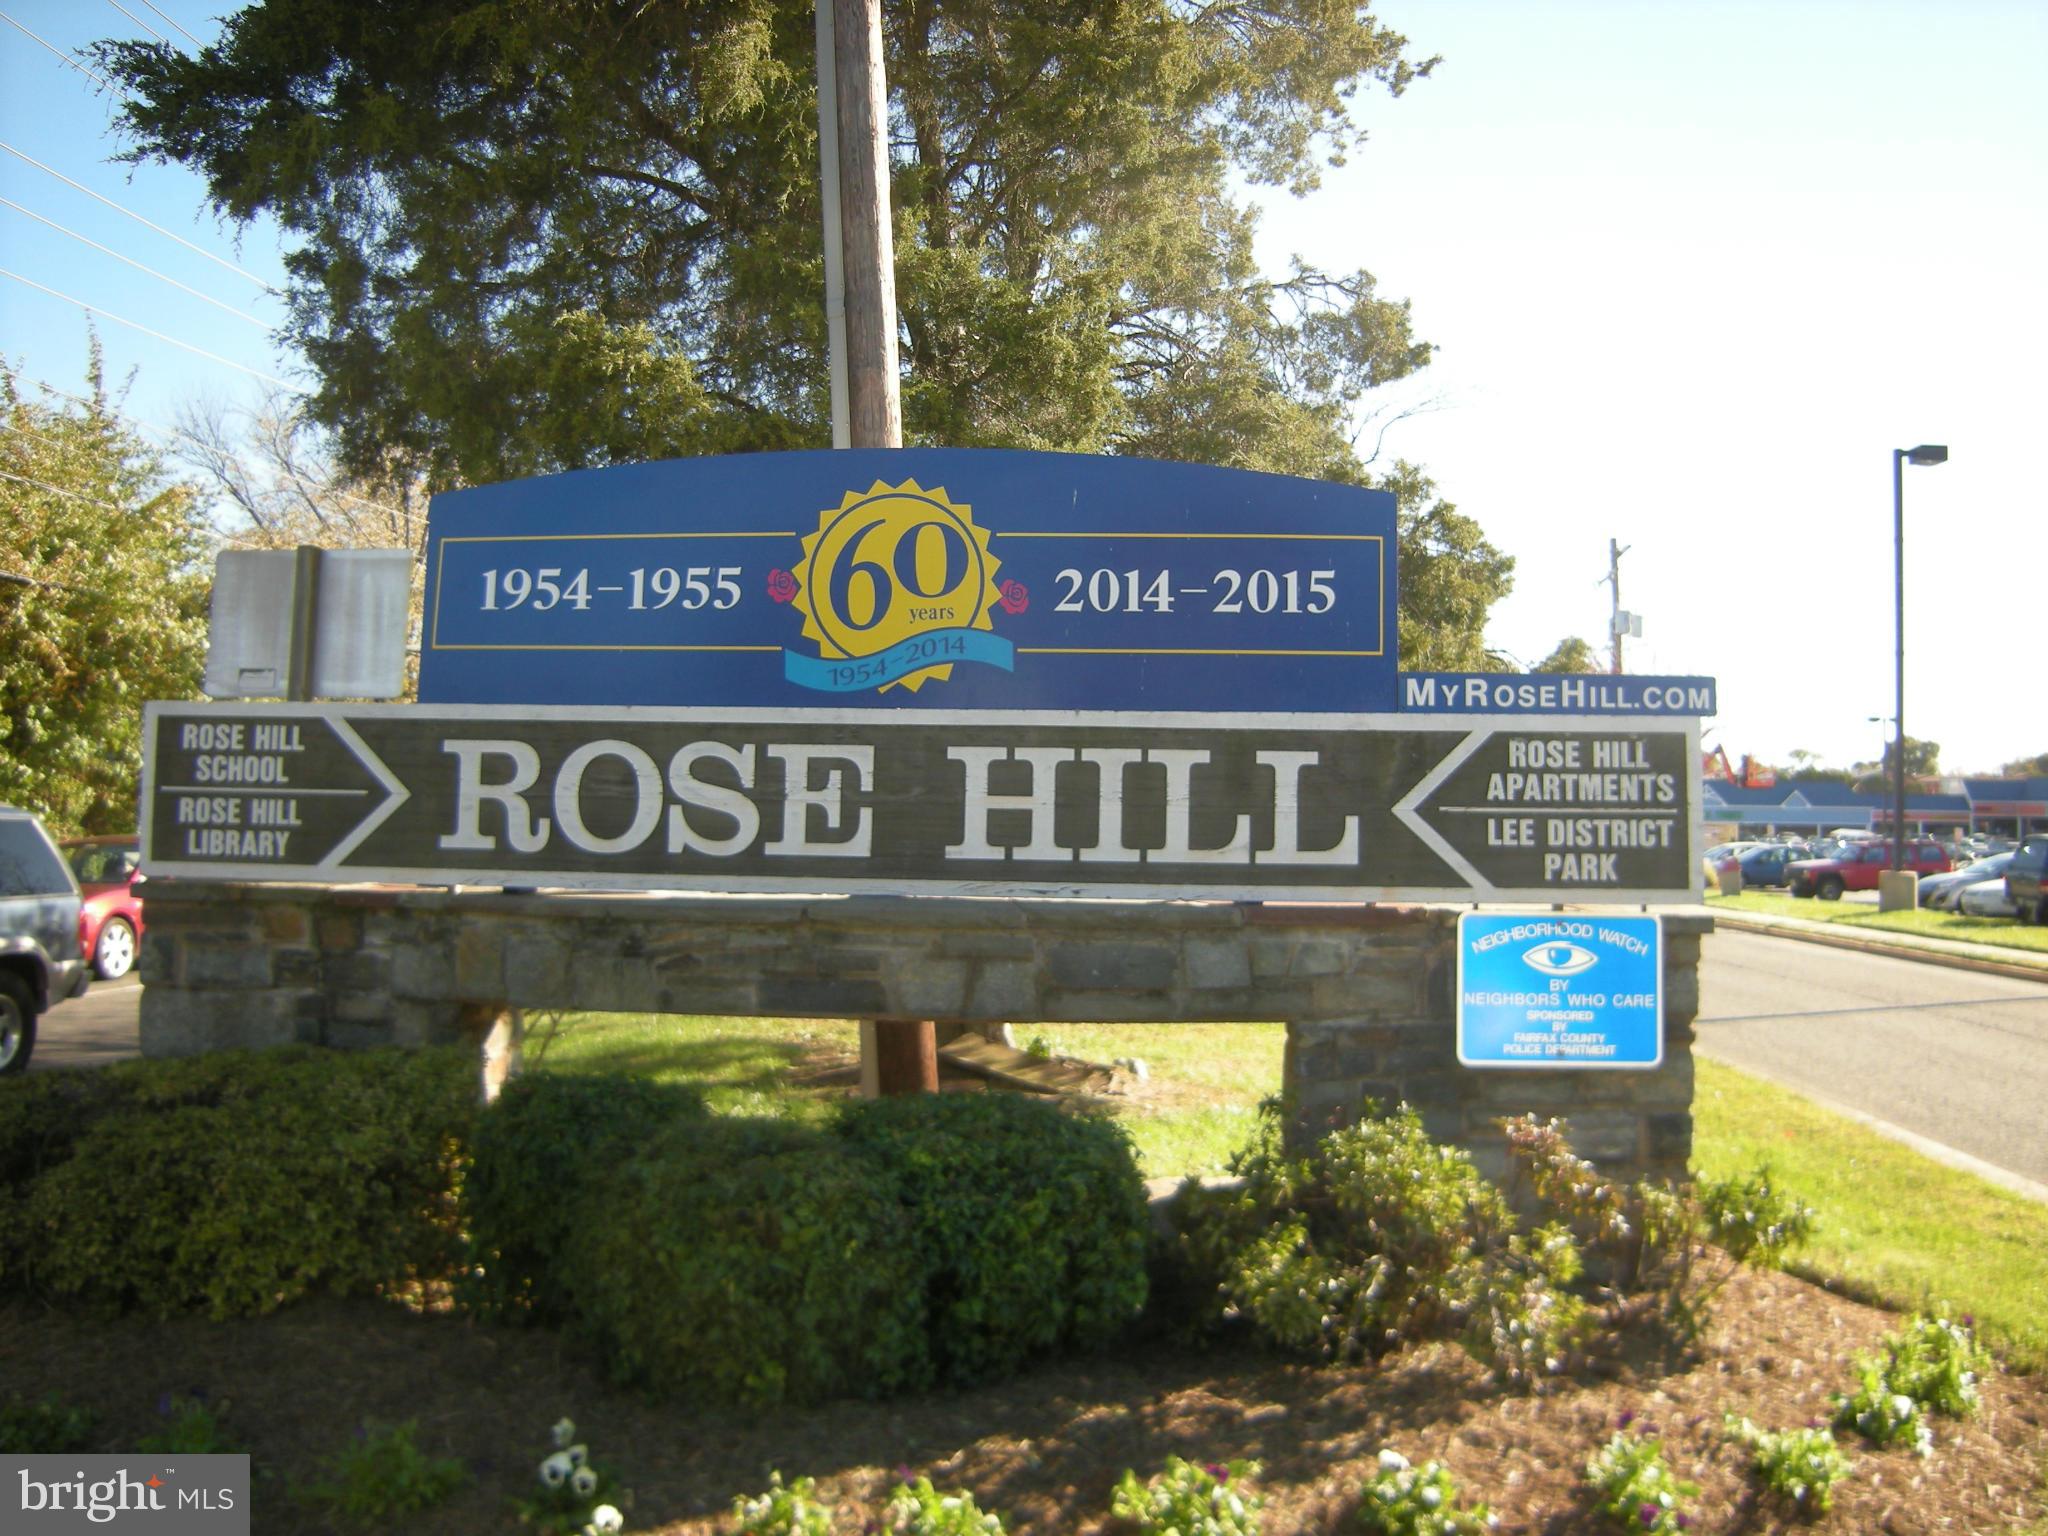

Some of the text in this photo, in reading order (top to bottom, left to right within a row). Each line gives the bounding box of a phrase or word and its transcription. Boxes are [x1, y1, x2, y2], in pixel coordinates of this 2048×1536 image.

[829, 519, 969, 631] 60
[909, 606, 954, 624] years
[182, 724, 305, 750] ROSE HILL
[1508, 739, 1650, 768] ROSE HILL
[196, 755, 289, 782] SCHOOL
[1486, 773, 1675, 801] APARTMENTS
[178, 797, 303, 825] ROSE HILL
[439, 739, 1360, 865] ROSE HILL
[187, 829, 291, 857] LIBRARY
[1487, 818, 1674, 847] LEE DISTRICT
[1543, 853, 1617, 881] PARK
[1471, 922, 1649, 957] NEIGHBORHOOD WATCH
[1549, 979, 1570, 992] BY
[1464, 992, 1655, 1008] NEIGHBORS WHO CARE
[1526, 1010, 1595, 1021] SPONSORED
[1551, 1021, 1568, 1032] BY
[1503, 1043, 1617, 1056] POLICE DEPARTMENT
[1513, 1032, 1606, 1044] FAIRFAX COUNTY
